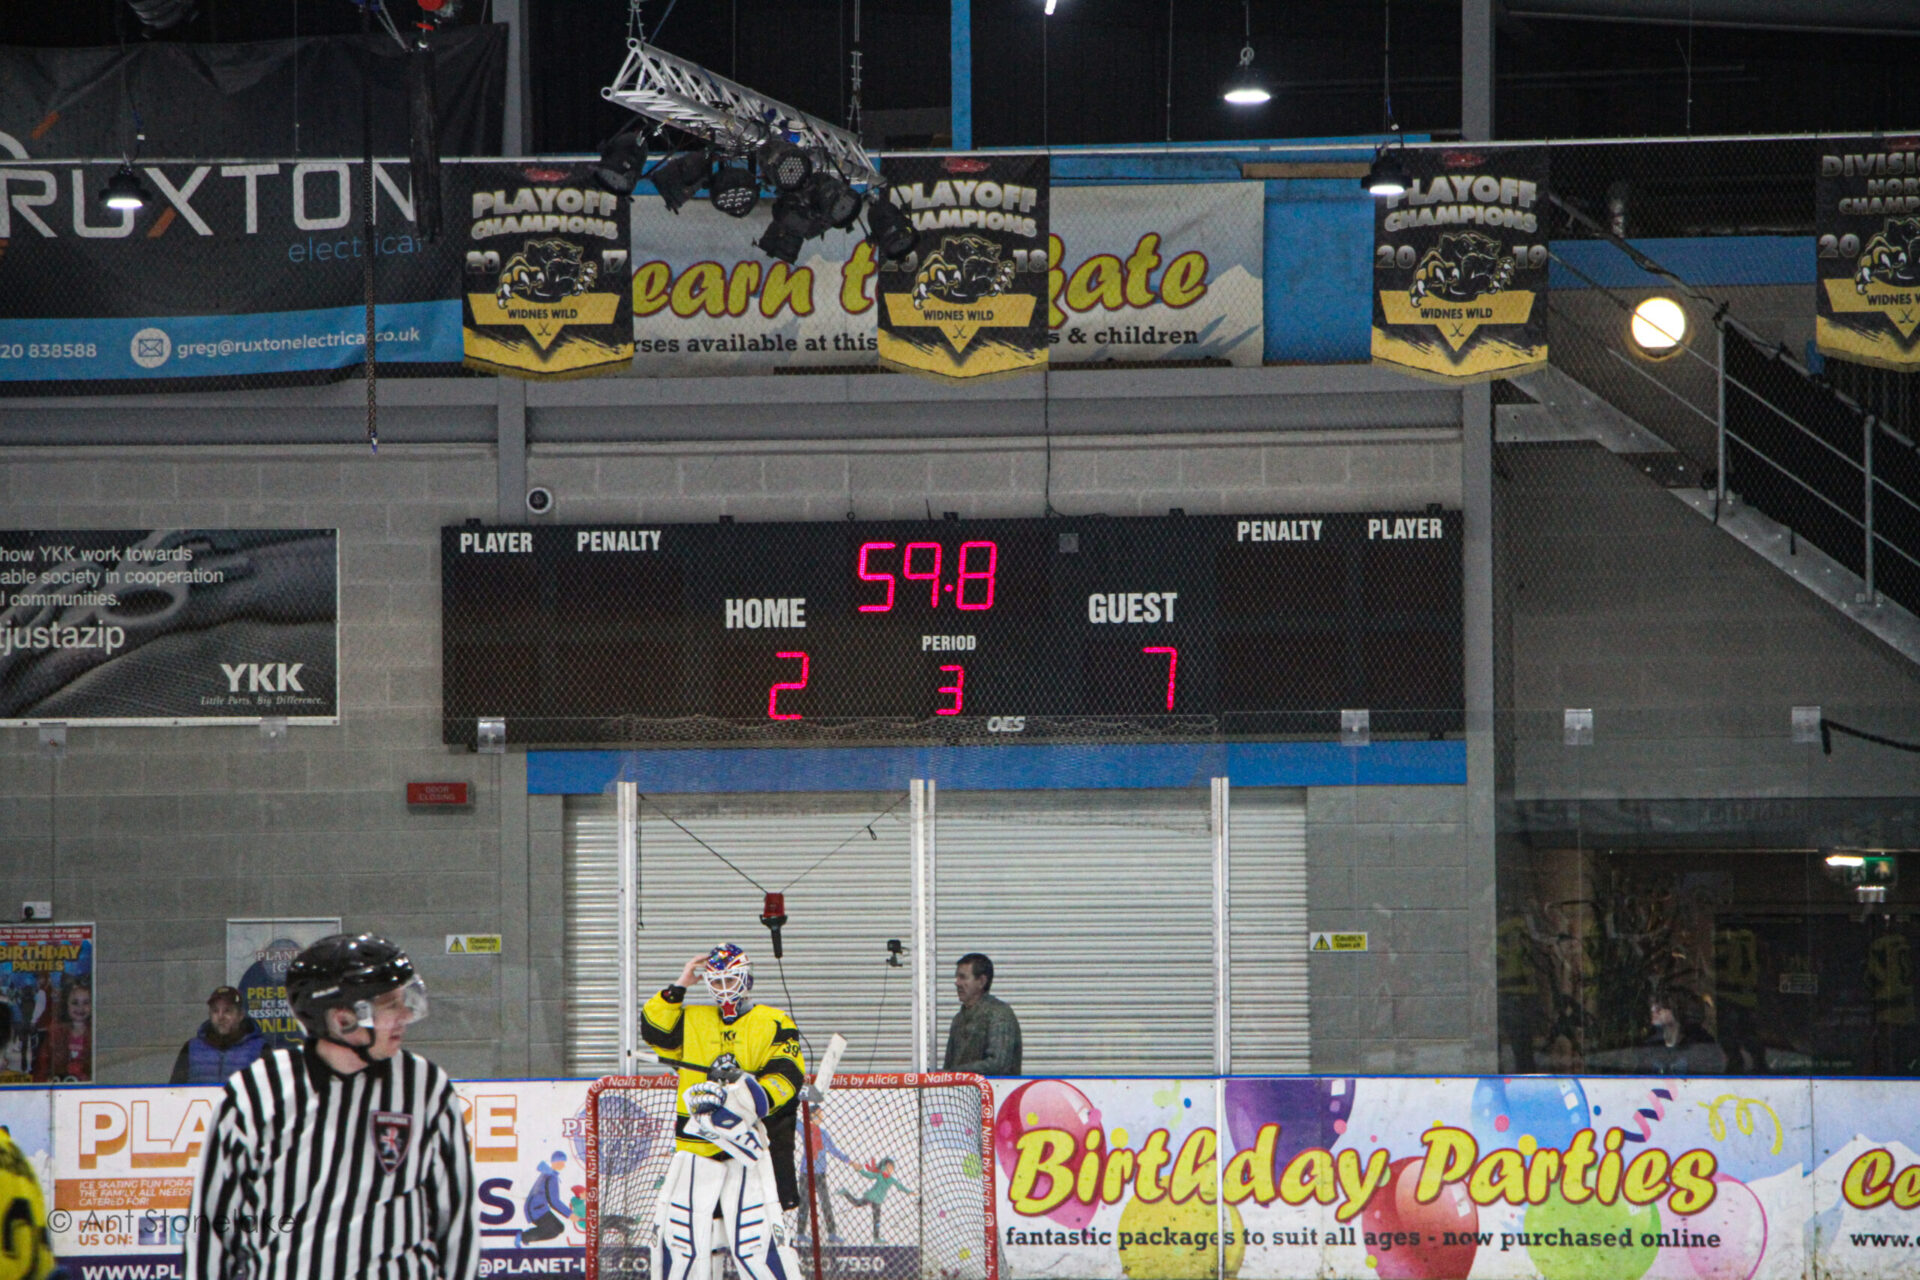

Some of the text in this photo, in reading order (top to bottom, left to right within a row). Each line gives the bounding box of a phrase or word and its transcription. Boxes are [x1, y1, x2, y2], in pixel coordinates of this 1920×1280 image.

[1821, 152, 1920, 178] DIVISI
[889, 180, 1038, 214] PLAYOFF
[1867, 177, 1920, 196] NOR
[472, 186, 618, 219] PLAYOFF
[471, 214, 619, 241] CHAMPIONS
[911, 209, 1038, 239] AMPIONS
[1384, 205, 1538, 233] CHAMPIONS
[1819, 233, 1860, 258] 20
[602, 249, 628, 274] 17
[1012, 248, 1048, 273] 18
[1376, 244, 1548, 270] 20 19
[1867, 294, 1912, 305] WIDNES
[507, 308, 578, 319] WIDNES WILD
[923, 309, 994, 321] WIDNES WILD
[1420, 308, 1493, 319] WIDNES WILD
[687, 334, 797, 352] available
[805, 334, 827, 352] at
[834, 333, 877, 351] this
[1067, 327, 1087, 344] &
[1094, 326, 1199, 344] children
[28, 343, 97, 359] 838588
[1236, 520, 1323, 542] PENALTY
[1367, 518, 1443, 540] PLAYER
[460, 531, 533, 553] PLAYER
[577, 530, 662, 552] PENALTY
[40, 546, 76, 561] YKK
[81, 546, 121, 561] work
[126, 545, 193, 561] towards
[41, 568, 101, 588] society
[105, 568, 120, 584] in
[125, 567, 224, 588] cooperation
[858, 540, 998, 613] 59.8
[10, 590, 121, 607] communities.
[1088, 591, 1178, 624] GUEST
[725, 598, 807, 629] HOME
[921, 635, 977, 652] PERIOD
[220, 663, 305, 692] YKK
[768, 650, 809, 720] 2
[1142, 646, 1178, 711] 7
[936, 664, 965, 716] 3
[0, 944, 81, 962] BIRTHDAY
[12, 960, 64, 972] PARTIES
[782, 1040, 801, 1058] 39
[608, 1077, 636, 1088] Nails
[639, 1079, 654, 1090] by
[830, 1073, 899, 1087] ails by Alicia
[1008, 1122, 1719, 1222] Birthday Parties
[80, 1180, 95, 1190] ICE
[98, 1179, 139, 1189] SKATING
[141, 1179, 162, 1189] FUN
[164, 1178, 185, 1188] FOR
[80, 1189, 98, 1198] THE
[138, 1188, 156, 1197] ALL
[159, 1187, 192, 1197] NEEDS
[79, 1197, 124, 1207] CATERED
[79, 1219, 118, 1232] FIND
[79, 1233, 133, 1247] US ON:
[1006, 1227, 1112, 1247] fantastic
[1118, 1227, 1235, 1251] packages
[1242, 1229, 1265, 1246] to
[1272, 1227, 1318, 1246] suit
[1325, 1226, 1357, 1246] all
[1364, 1231, 1421, 1251] ages
[1443, 1231, 1494, 1247] now
[1500, 1226, 1634, 1251] purchased
[1641, 1226, 1721, 1247] online
